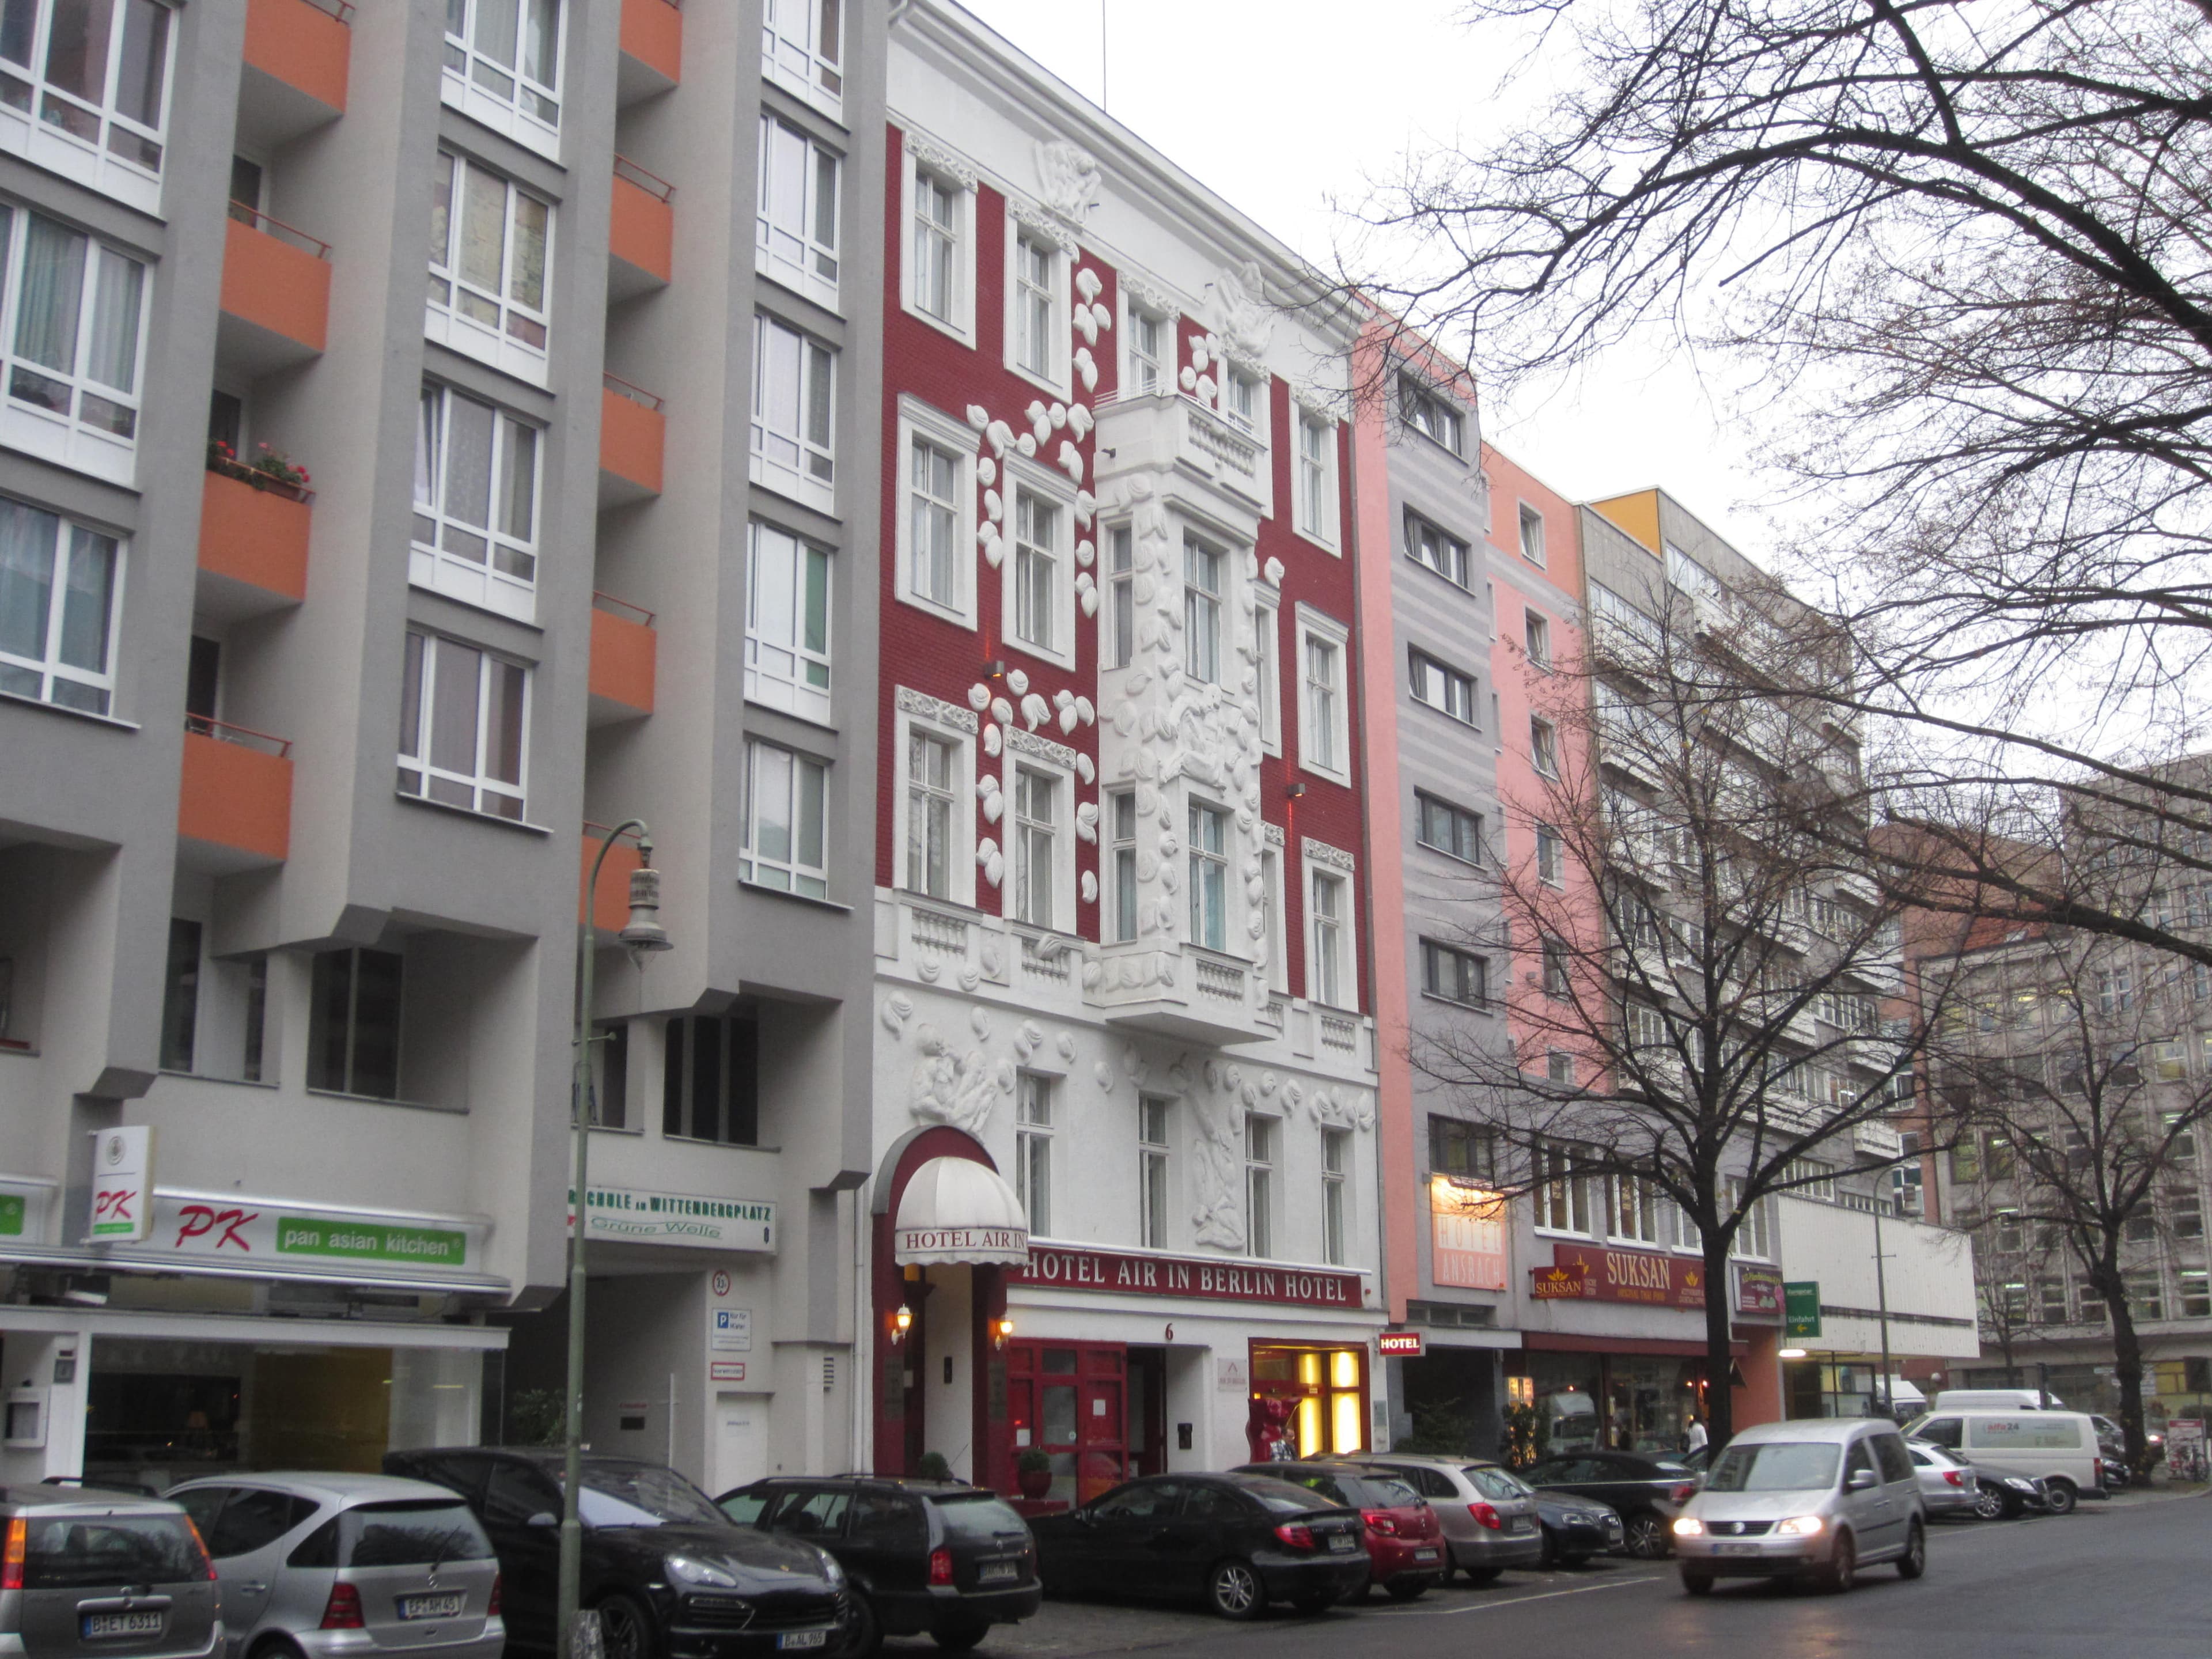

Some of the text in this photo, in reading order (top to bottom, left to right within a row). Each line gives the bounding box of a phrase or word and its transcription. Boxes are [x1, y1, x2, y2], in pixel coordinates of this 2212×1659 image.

[94, 1190, 138, 1222] PK
[649, 1196, 771, 1221] WITTENBERGPLATZ
[175, 1205, 449, 1256] PK pan asian kitchen
[591, 1218, 721, 1238] Grüne Welle
[905, 1230, 1025, 1249] HOTEL AIR IN
[1022, 1252, 1346, 1301] HOTEL AIR IN BERLIN HOTEL
[1443, 1252, 1500, 1286] ANSBACH
[1606, 1252, 1671, 1290] SUKSAN
[1536, 1281, 1581, 1294] SUKSAN
[1788, 1315, 1816, 1324] Einfahrt
[1165, 1323, 1174, 1340] 6
[1381, 1338, 1420, 1349] HOTEL
